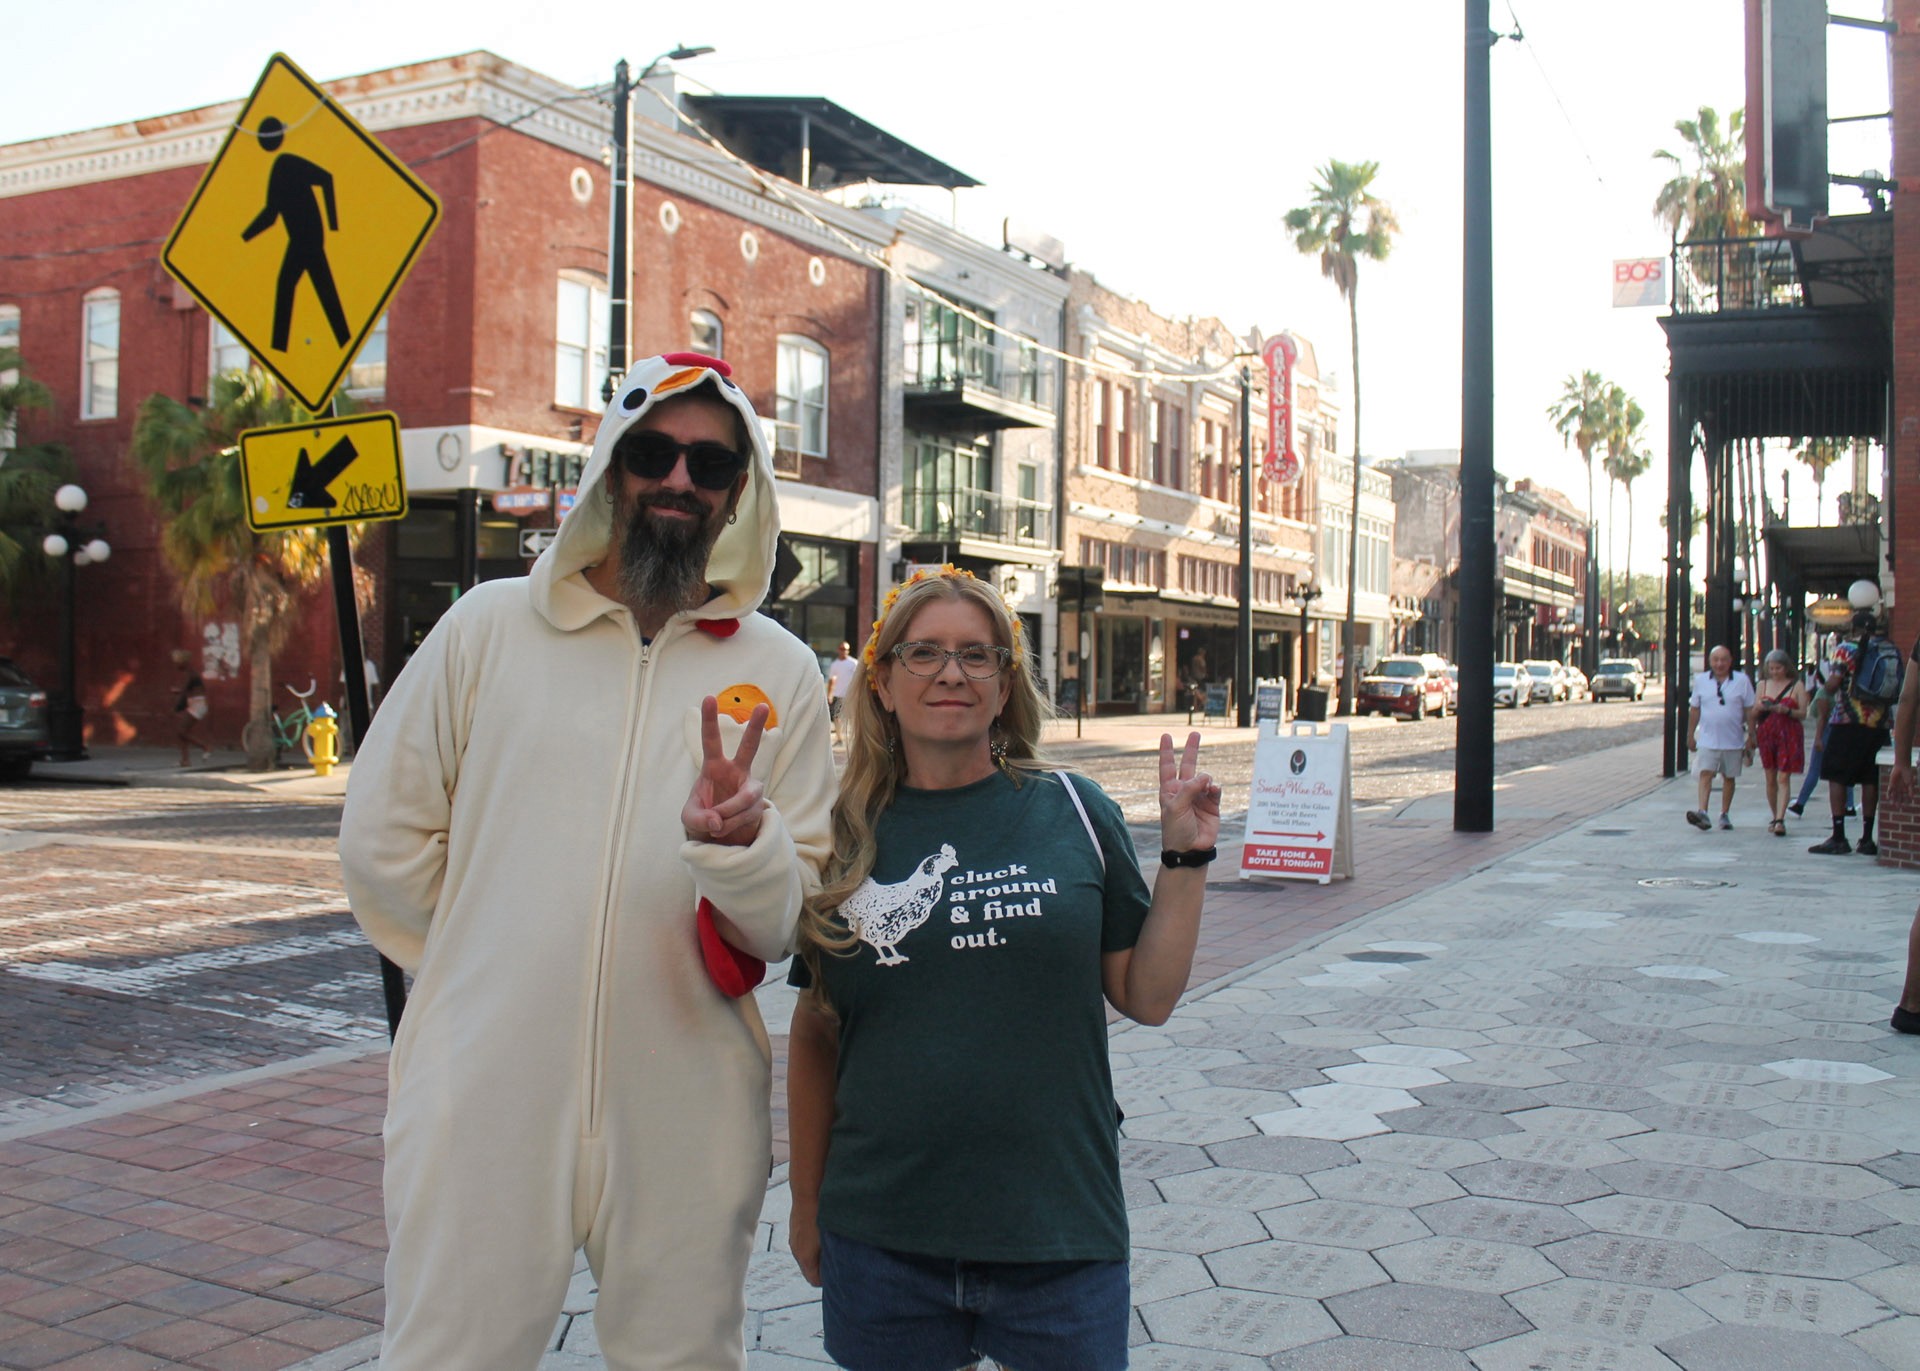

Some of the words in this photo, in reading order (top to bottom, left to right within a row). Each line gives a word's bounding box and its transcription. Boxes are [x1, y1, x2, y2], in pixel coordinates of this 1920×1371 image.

[1256, 778, 1286, 797] Society
[1286, 780, 1310, 795] Wine
[1248, 856, 1281, 867] BOTTLE
[1283, 859, 1324, 870] TONIGHT!
[1256, 848, 1279, 858] TAKE
[1280, 850, 1307, 859] HOME
[1308, 852, 1316, 860] A
[950, 864, 1027, 885] cluck
[949, 878, 1058, 902] around
[950, 905, 970, 924] &
[983, 898, 1043, 921] find
[950, 927, 1007, 950] out.
